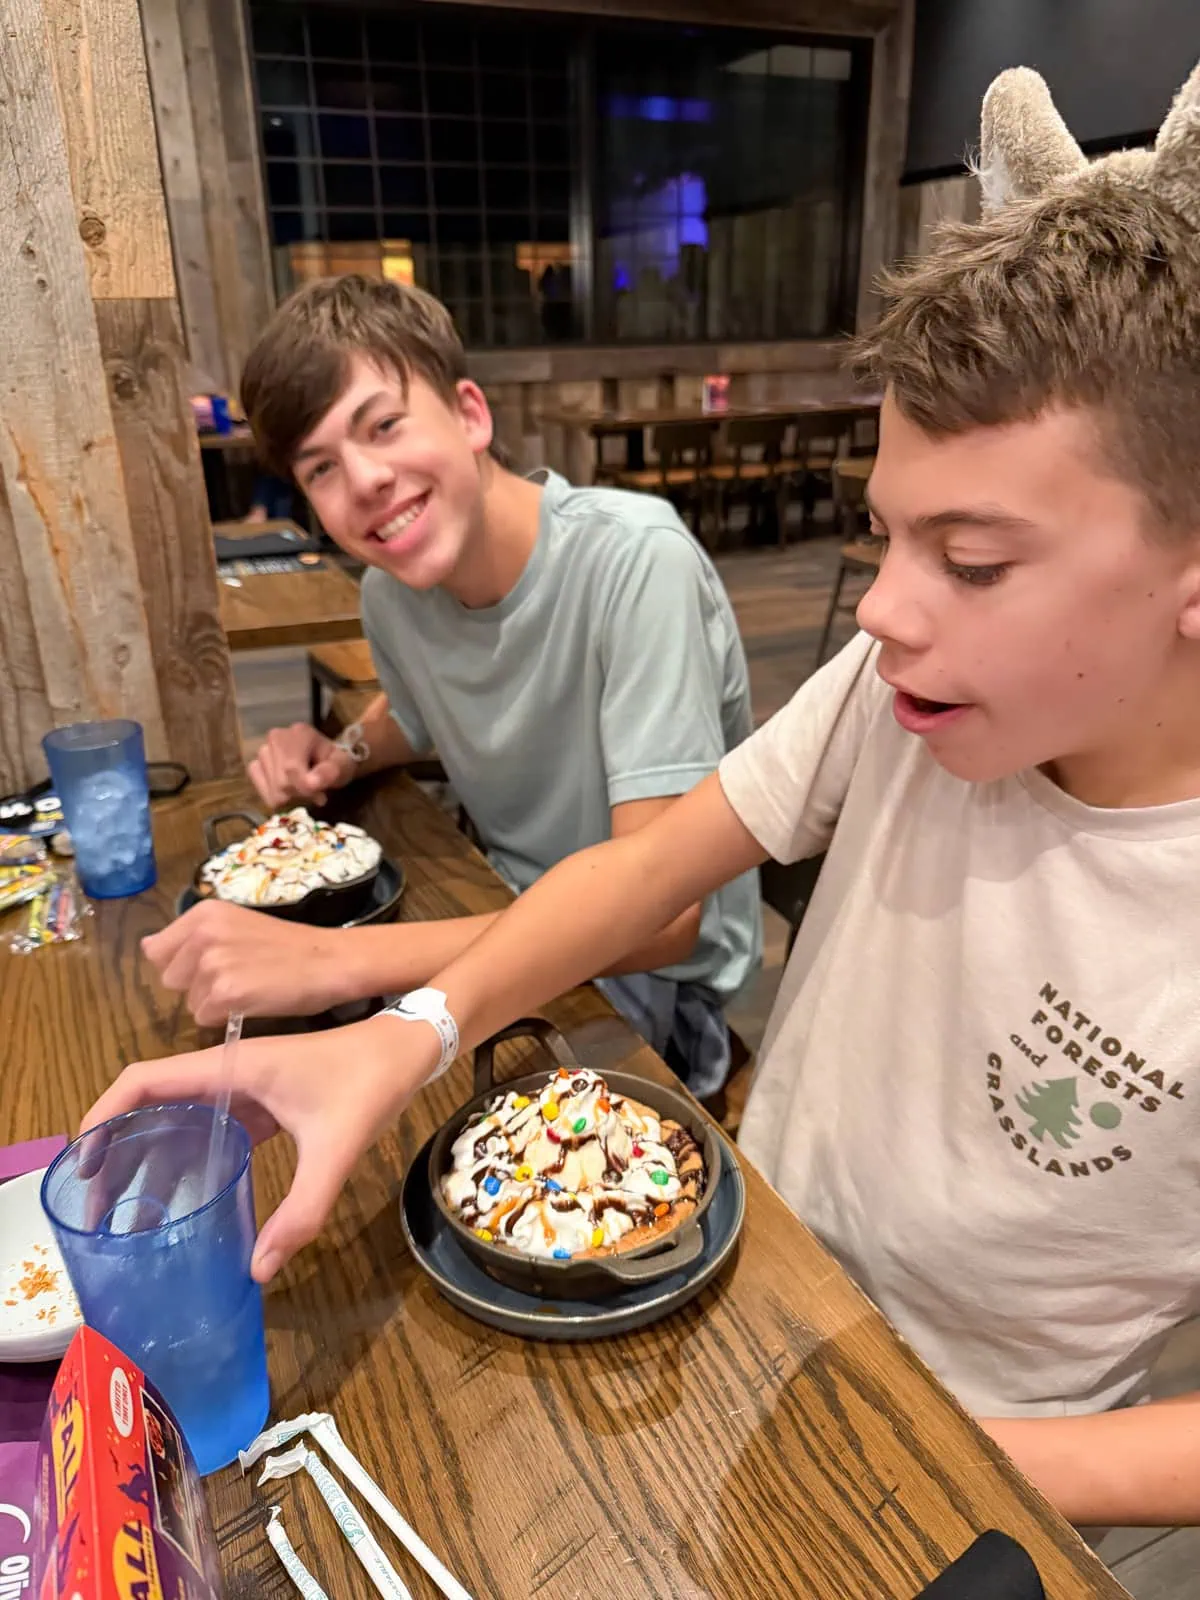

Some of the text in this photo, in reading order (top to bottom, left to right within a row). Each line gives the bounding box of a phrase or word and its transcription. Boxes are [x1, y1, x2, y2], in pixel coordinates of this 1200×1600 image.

[1009, 1033, 1049, 1069] and
[1030, 1009, 1162, 1113] FORESTS
[1038, 981, 1185, 1100] NATIONAL
[986, 1052, 1133, 1177] GRASSLANDS
[114, 1380, 122, 1417] LIMITED
[61, 1392, 79, 1517] FALL
